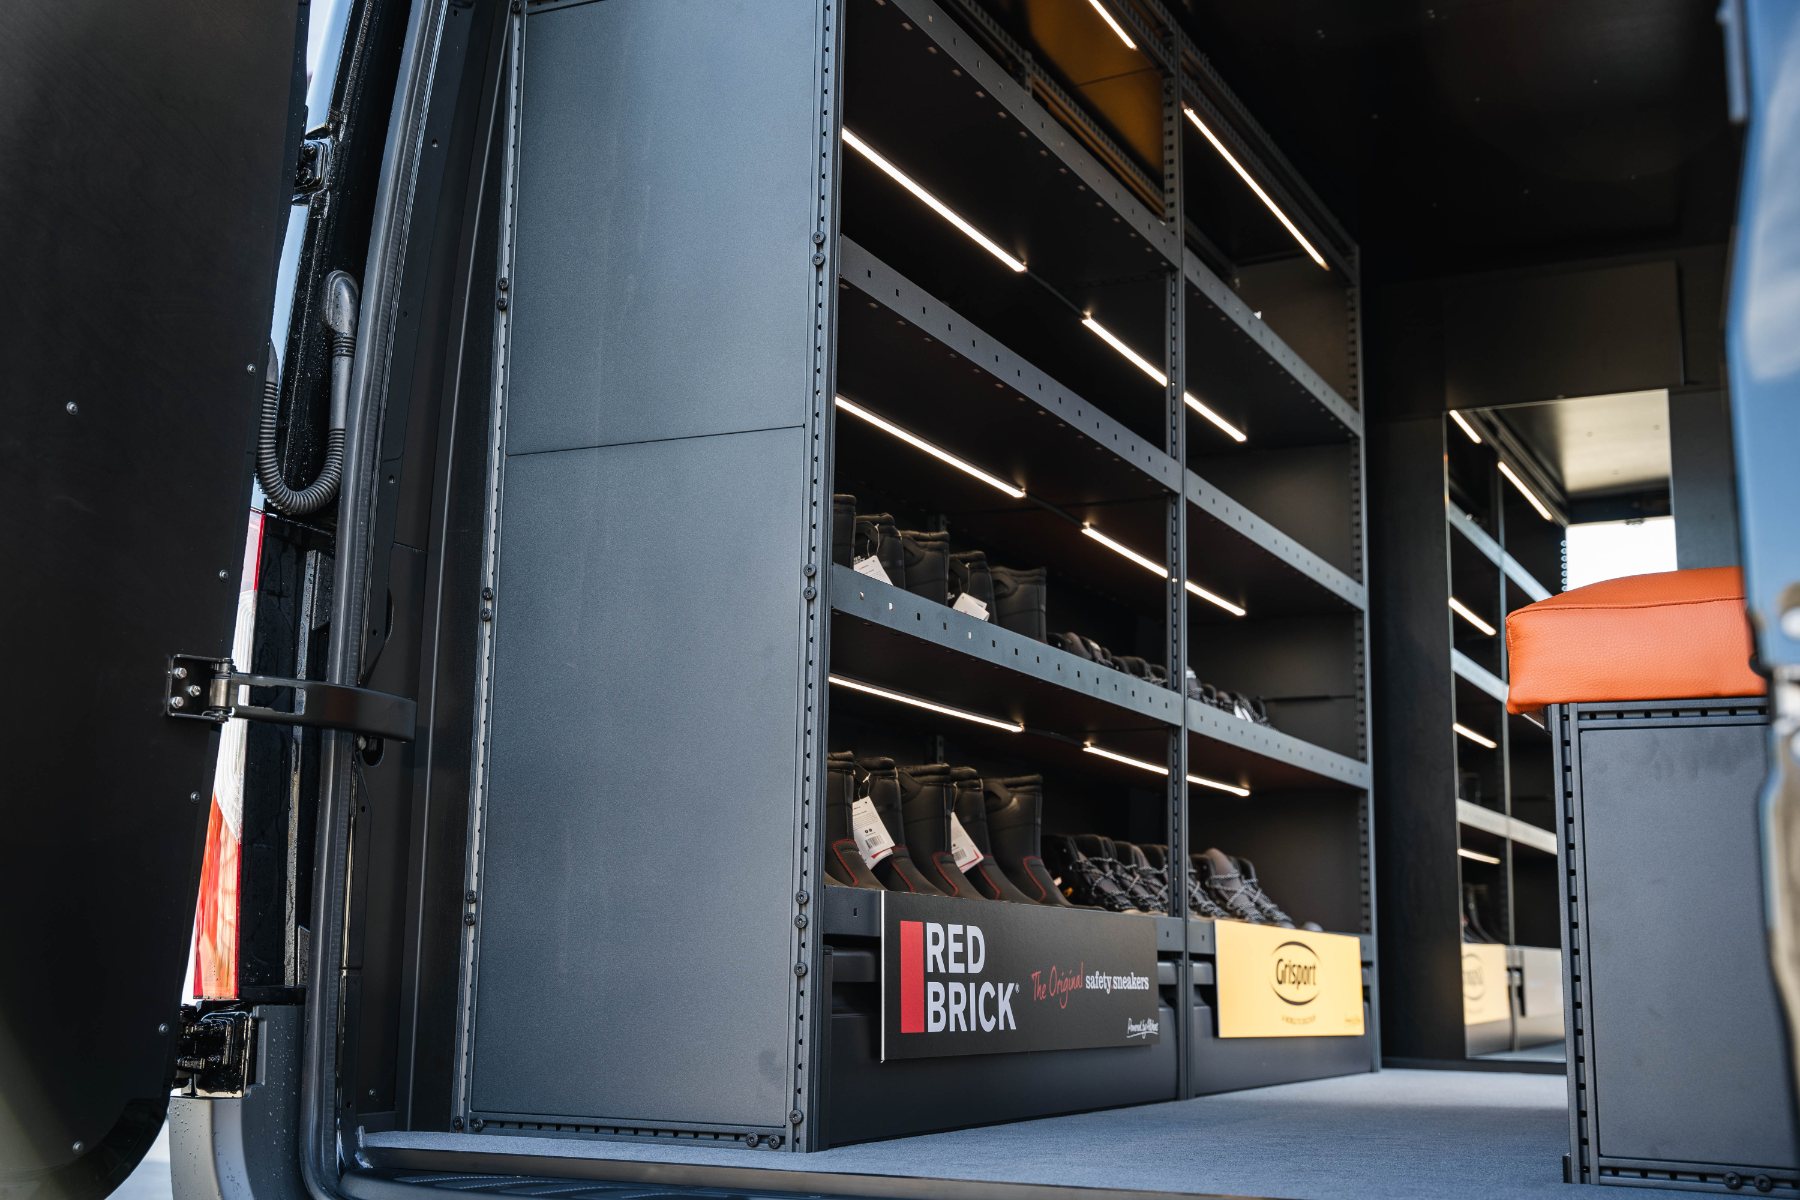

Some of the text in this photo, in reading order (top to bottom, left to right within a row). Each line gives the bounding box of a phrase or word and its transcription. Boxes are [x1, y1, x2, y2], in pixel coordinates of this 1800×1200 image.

[926, 922, 985, 974] RED
[1031, 960, 1150, 1009] The Original safety sneakers
[1275, 958, 1316, 990] Grisport
